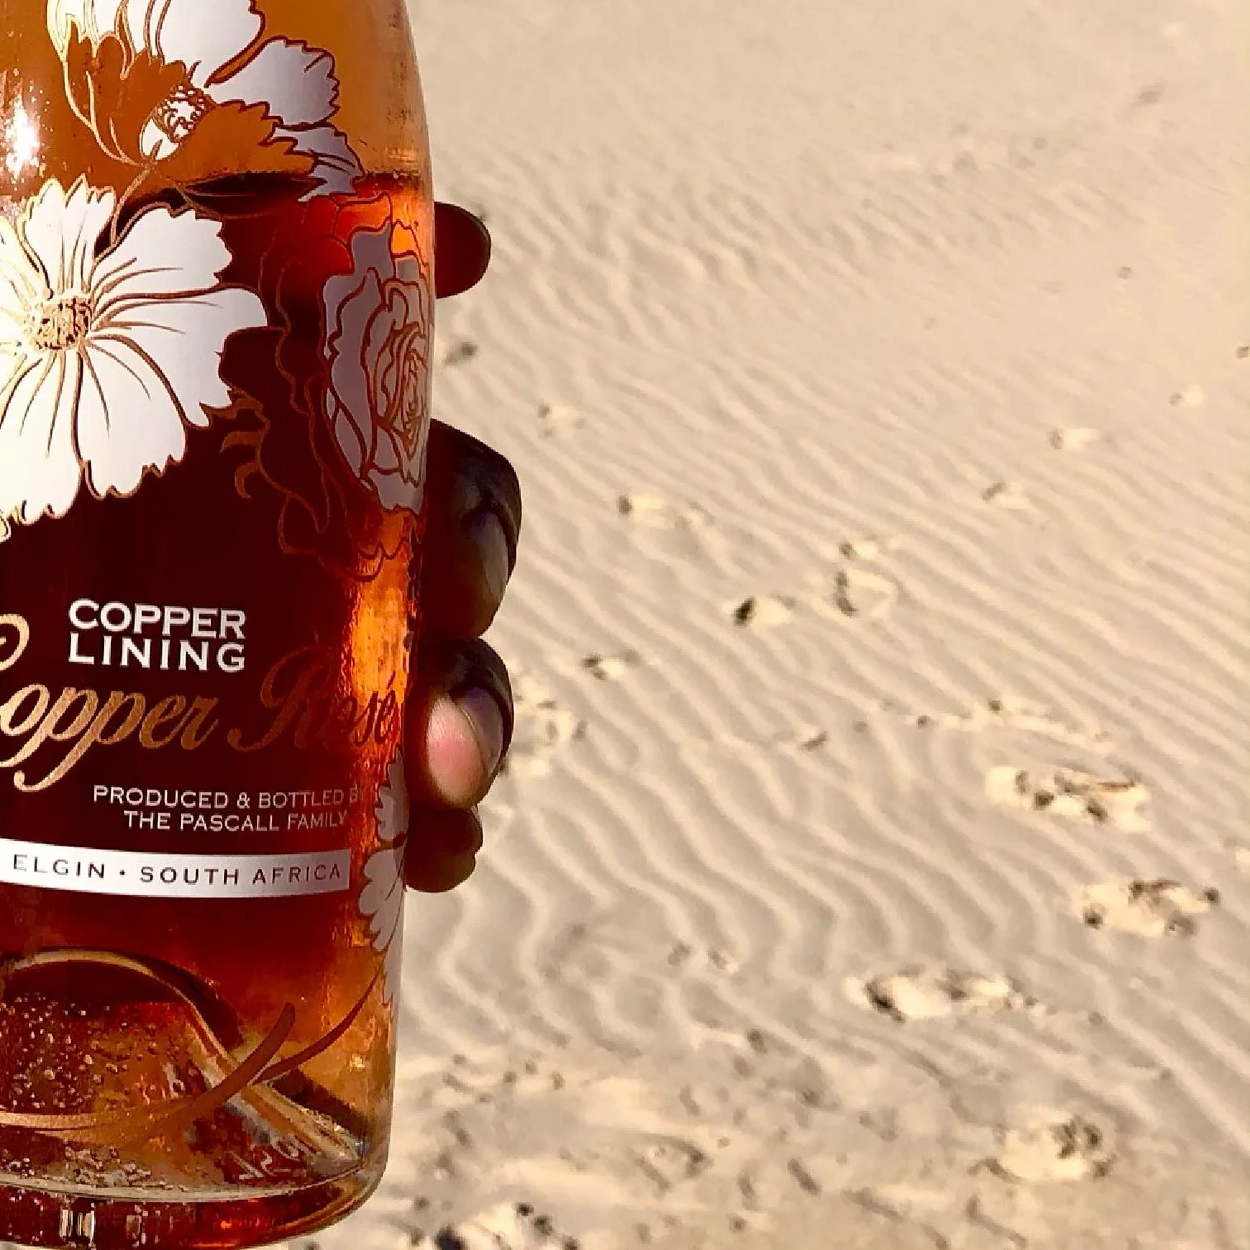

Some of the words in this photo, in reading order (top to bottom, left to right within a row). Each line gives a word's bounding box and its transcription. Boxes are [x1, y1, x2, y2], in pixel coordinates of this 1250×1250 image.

[68, 598, 247, 639] COPPER
[68, 632, 246, 673] LINING
[92, 784, 229, 809] PRODUCED
[236, 791, 251, 809] &
[258, 789, 346, 810] BOTTLED
[123, 810, 171, 830] THE
[179, 813, 279, 832] PASCALL
[286, 809, 348, 831] FAMILY
[12, 853, 106, 879] ELGIN
[139, 866, 240, 885] SOUTH
[251, 863, 341, 885] AFRICA
